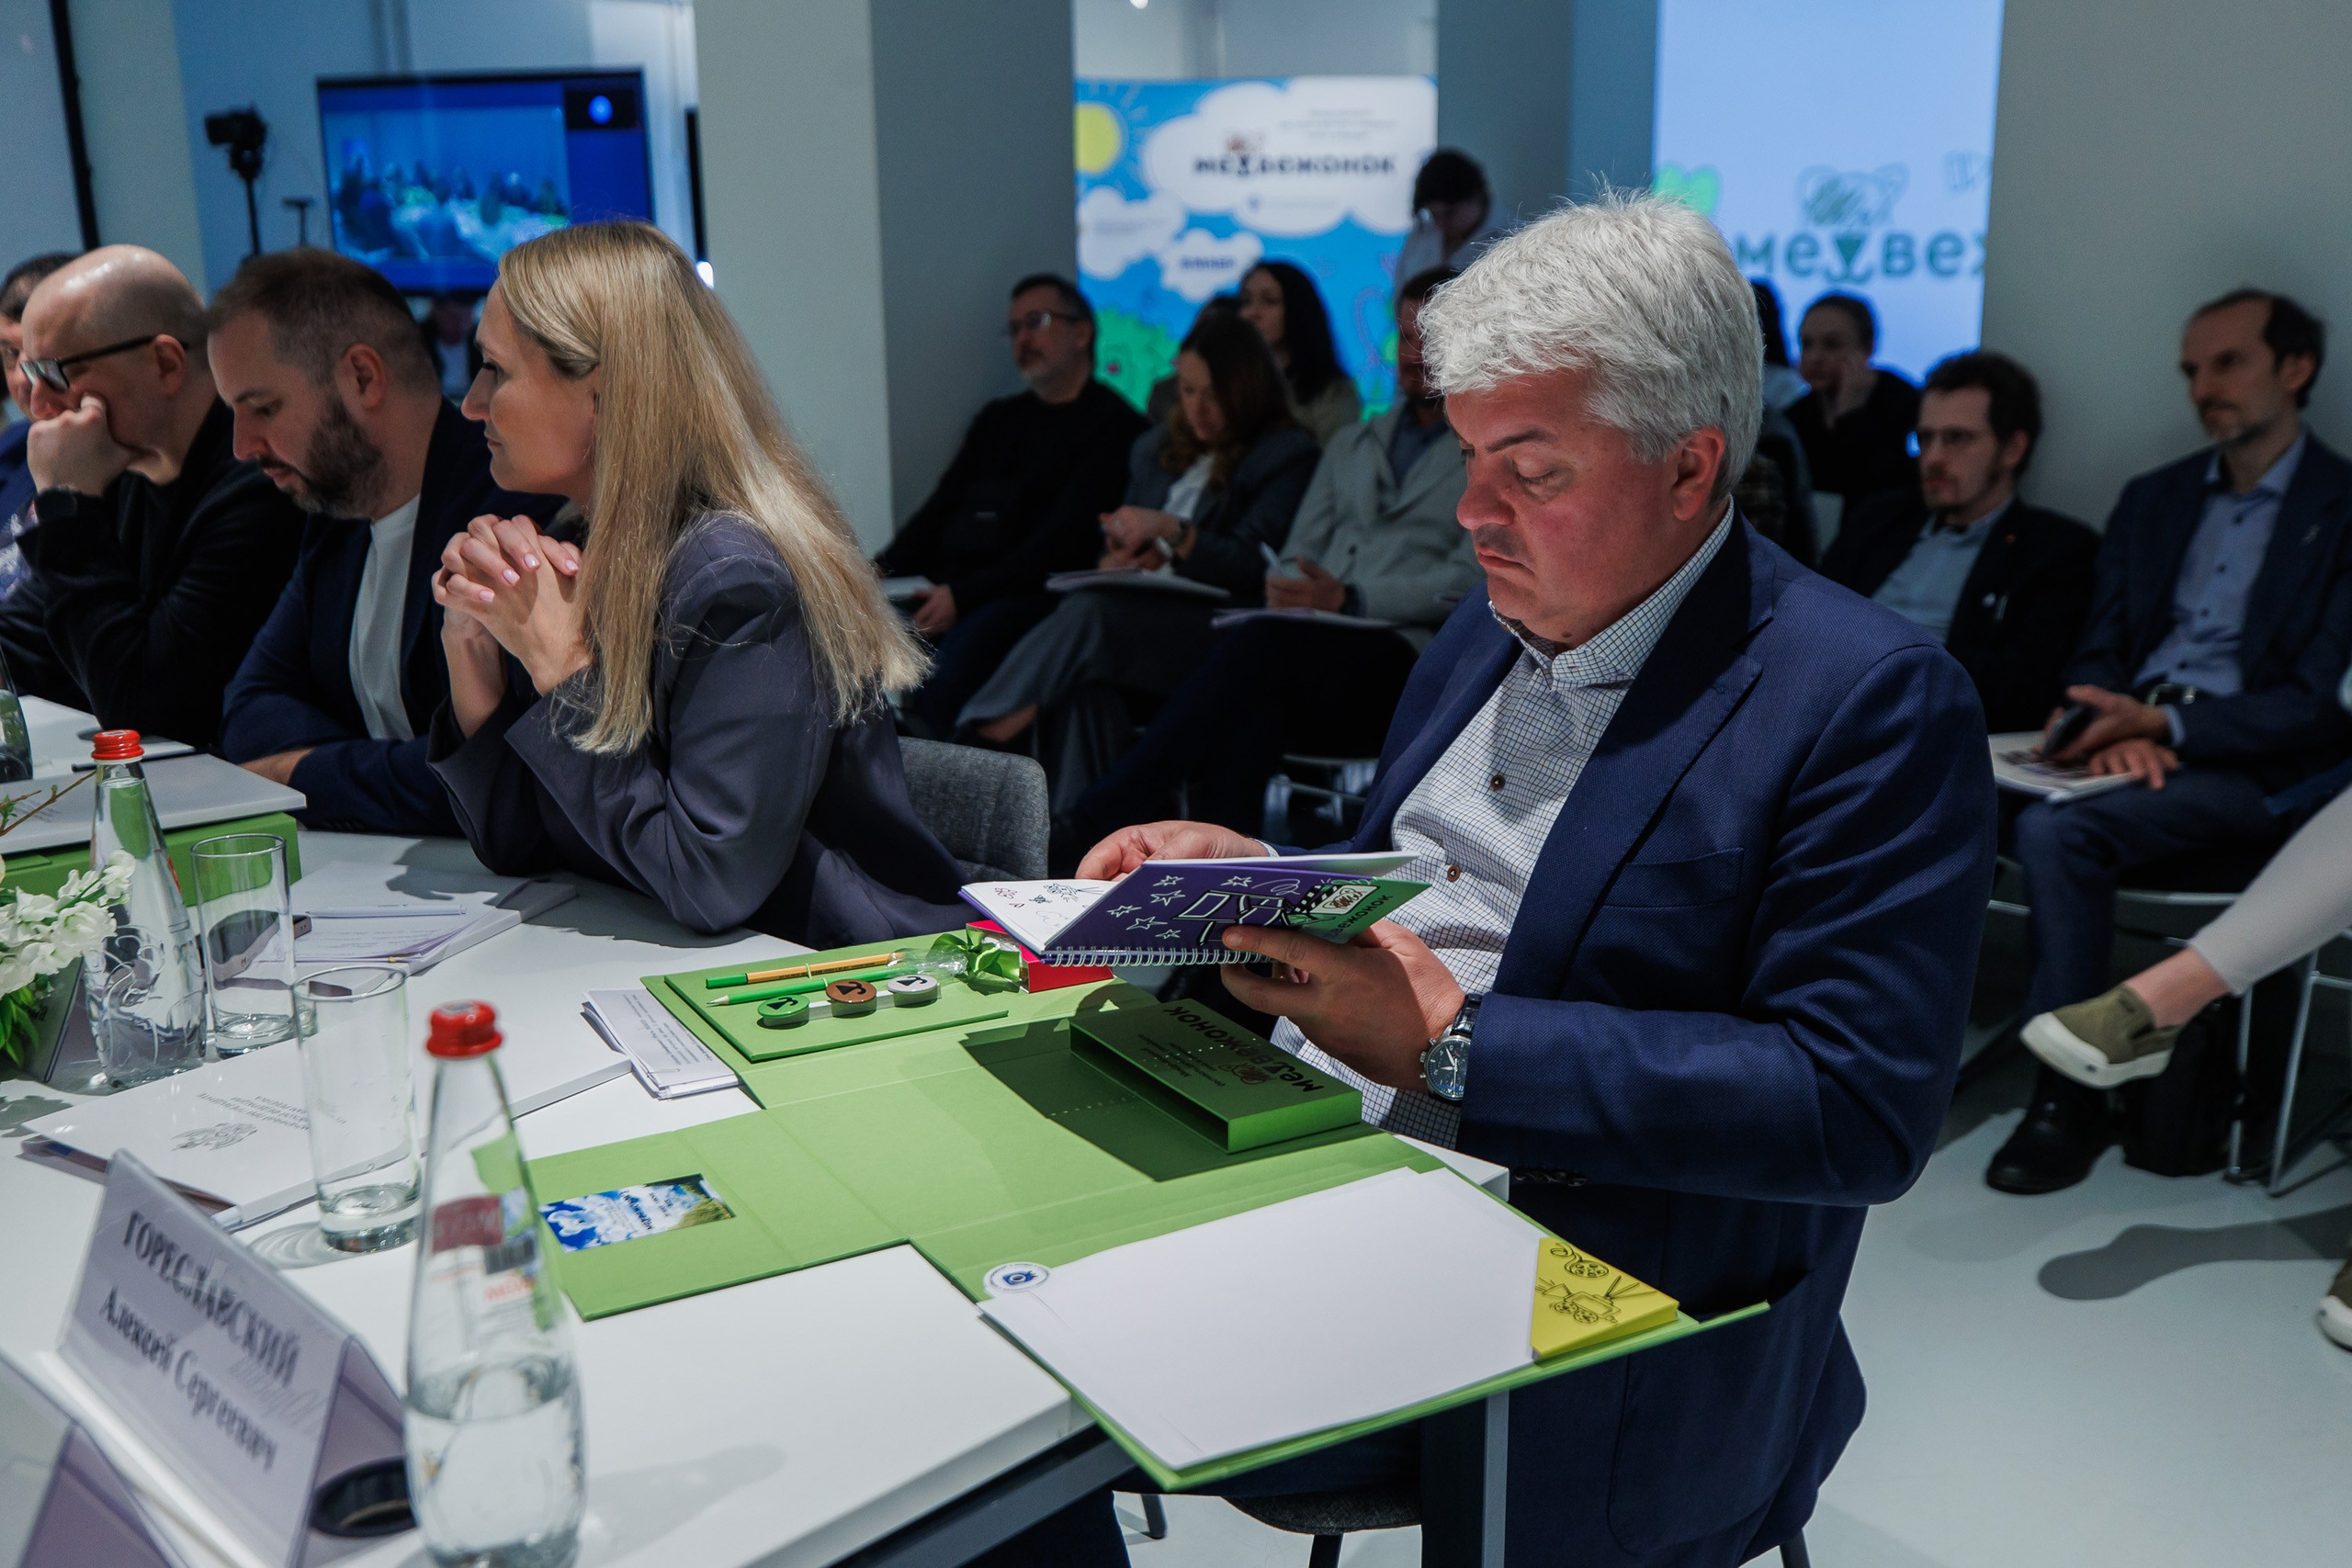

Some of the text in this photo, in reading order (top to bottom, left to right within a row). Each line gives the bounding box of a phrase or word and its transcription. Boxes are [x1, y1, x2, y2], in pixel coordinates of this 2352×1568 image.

[99, 1287, 277, 1472] Алексей Сергеевич
[123, 1211, 300, 1387] ГОРЕСЛАВСКИЙ
